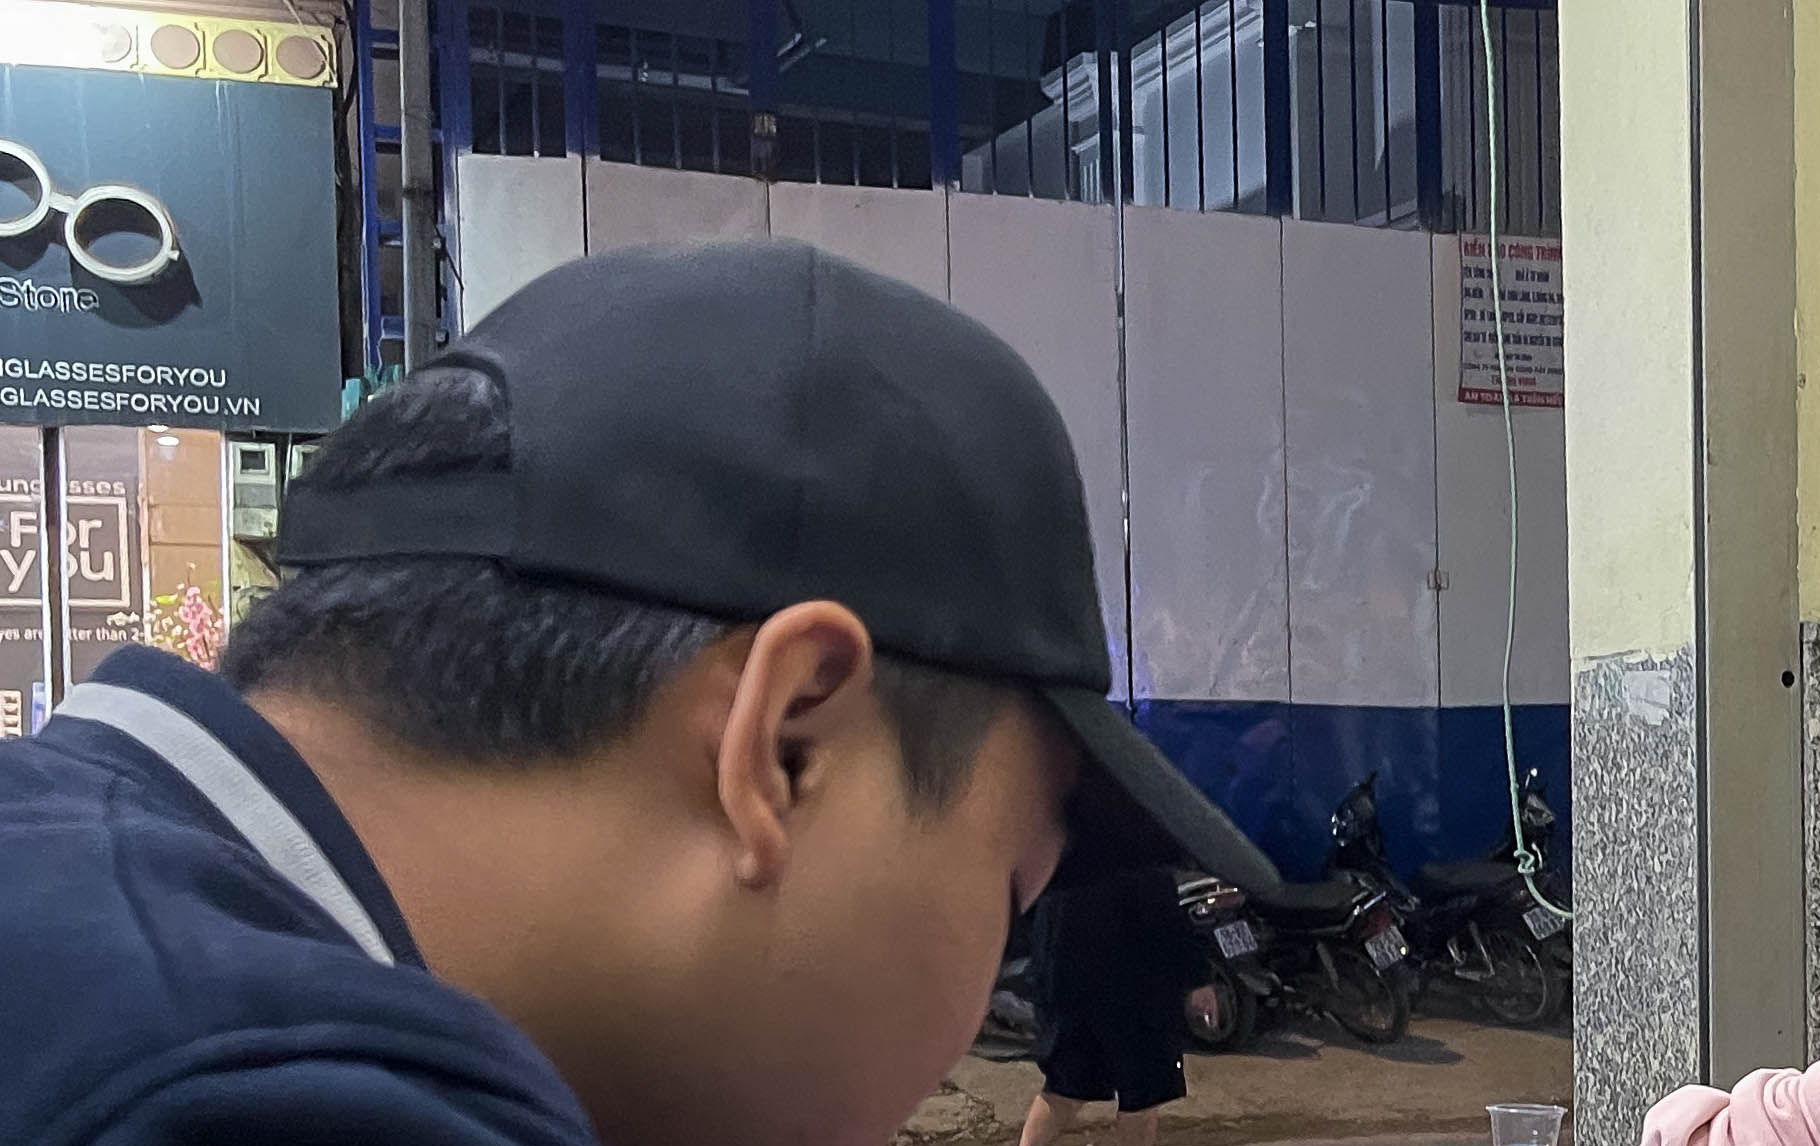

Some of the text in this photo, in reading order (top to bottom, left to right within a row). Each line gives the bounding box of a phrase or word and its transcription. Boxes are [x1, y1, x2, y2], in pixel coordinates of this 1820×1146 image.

[0, 358, 226, 388] GLASSESFORYOU
[11, 511, 102, 549] Fr
[0, 549, 114, 592] yu
